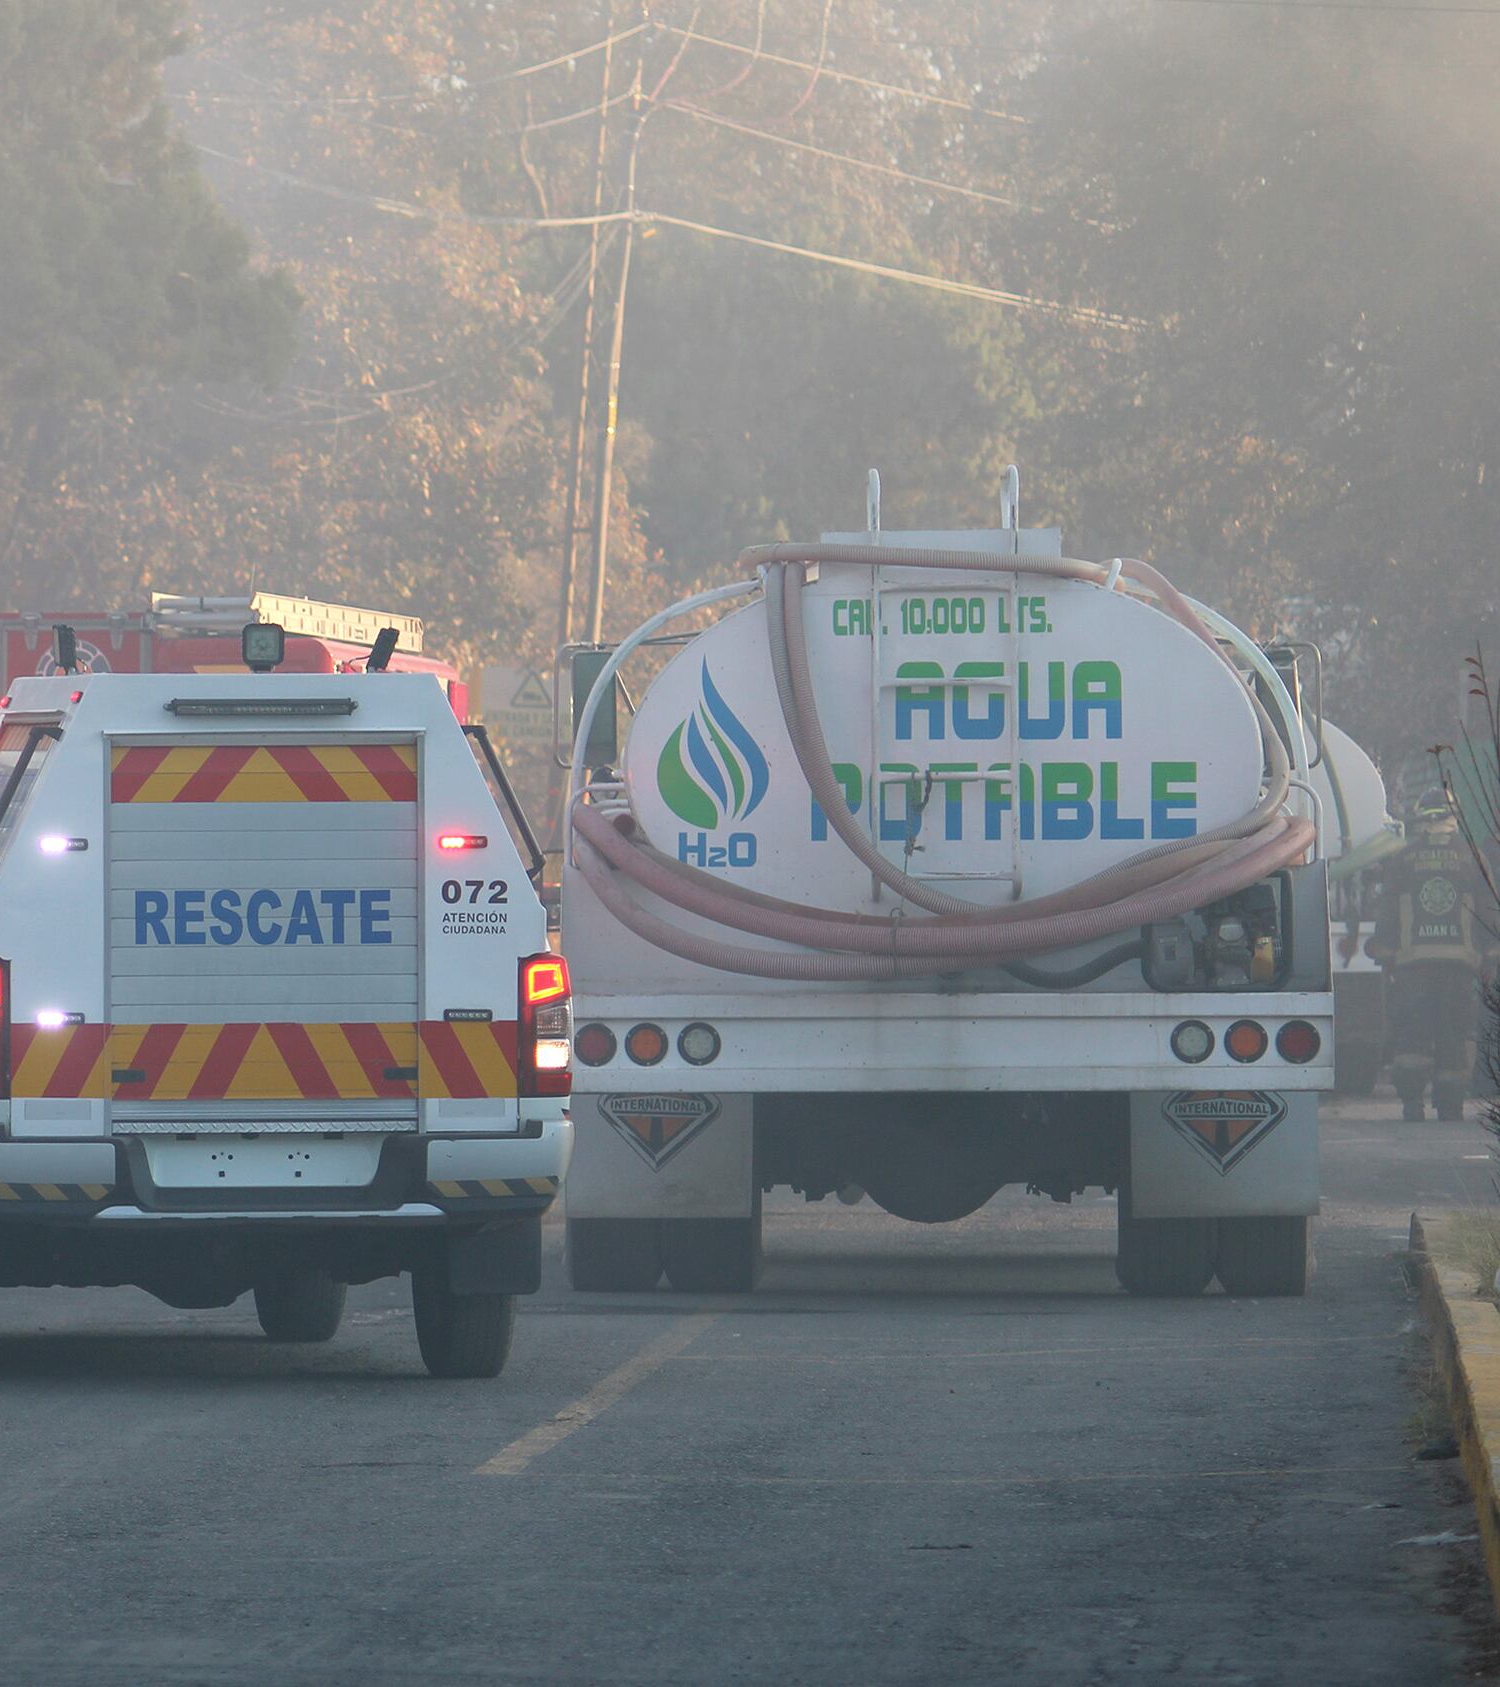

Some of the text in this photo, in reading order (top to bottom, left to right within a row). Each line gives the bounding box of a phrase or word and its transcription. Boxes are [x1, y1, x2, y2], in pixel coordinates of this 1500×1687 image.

[894, 660, 1123, 740] AGUA
[810, 761, 1198, 841] POTABLE
[678, 831, 757, 868] H2O
[441, 879, 509, 905] 072
[134, 888, 393, 946] RESCATE
[442, 911, 508, 923] ATENCIÓN
[442, 925, 507, 935] CIUDADANA
[610, 1098, 704, 1113] INTERNATIONAL
[1174, 1100, 1269, 1115] INTERNATIONAL
